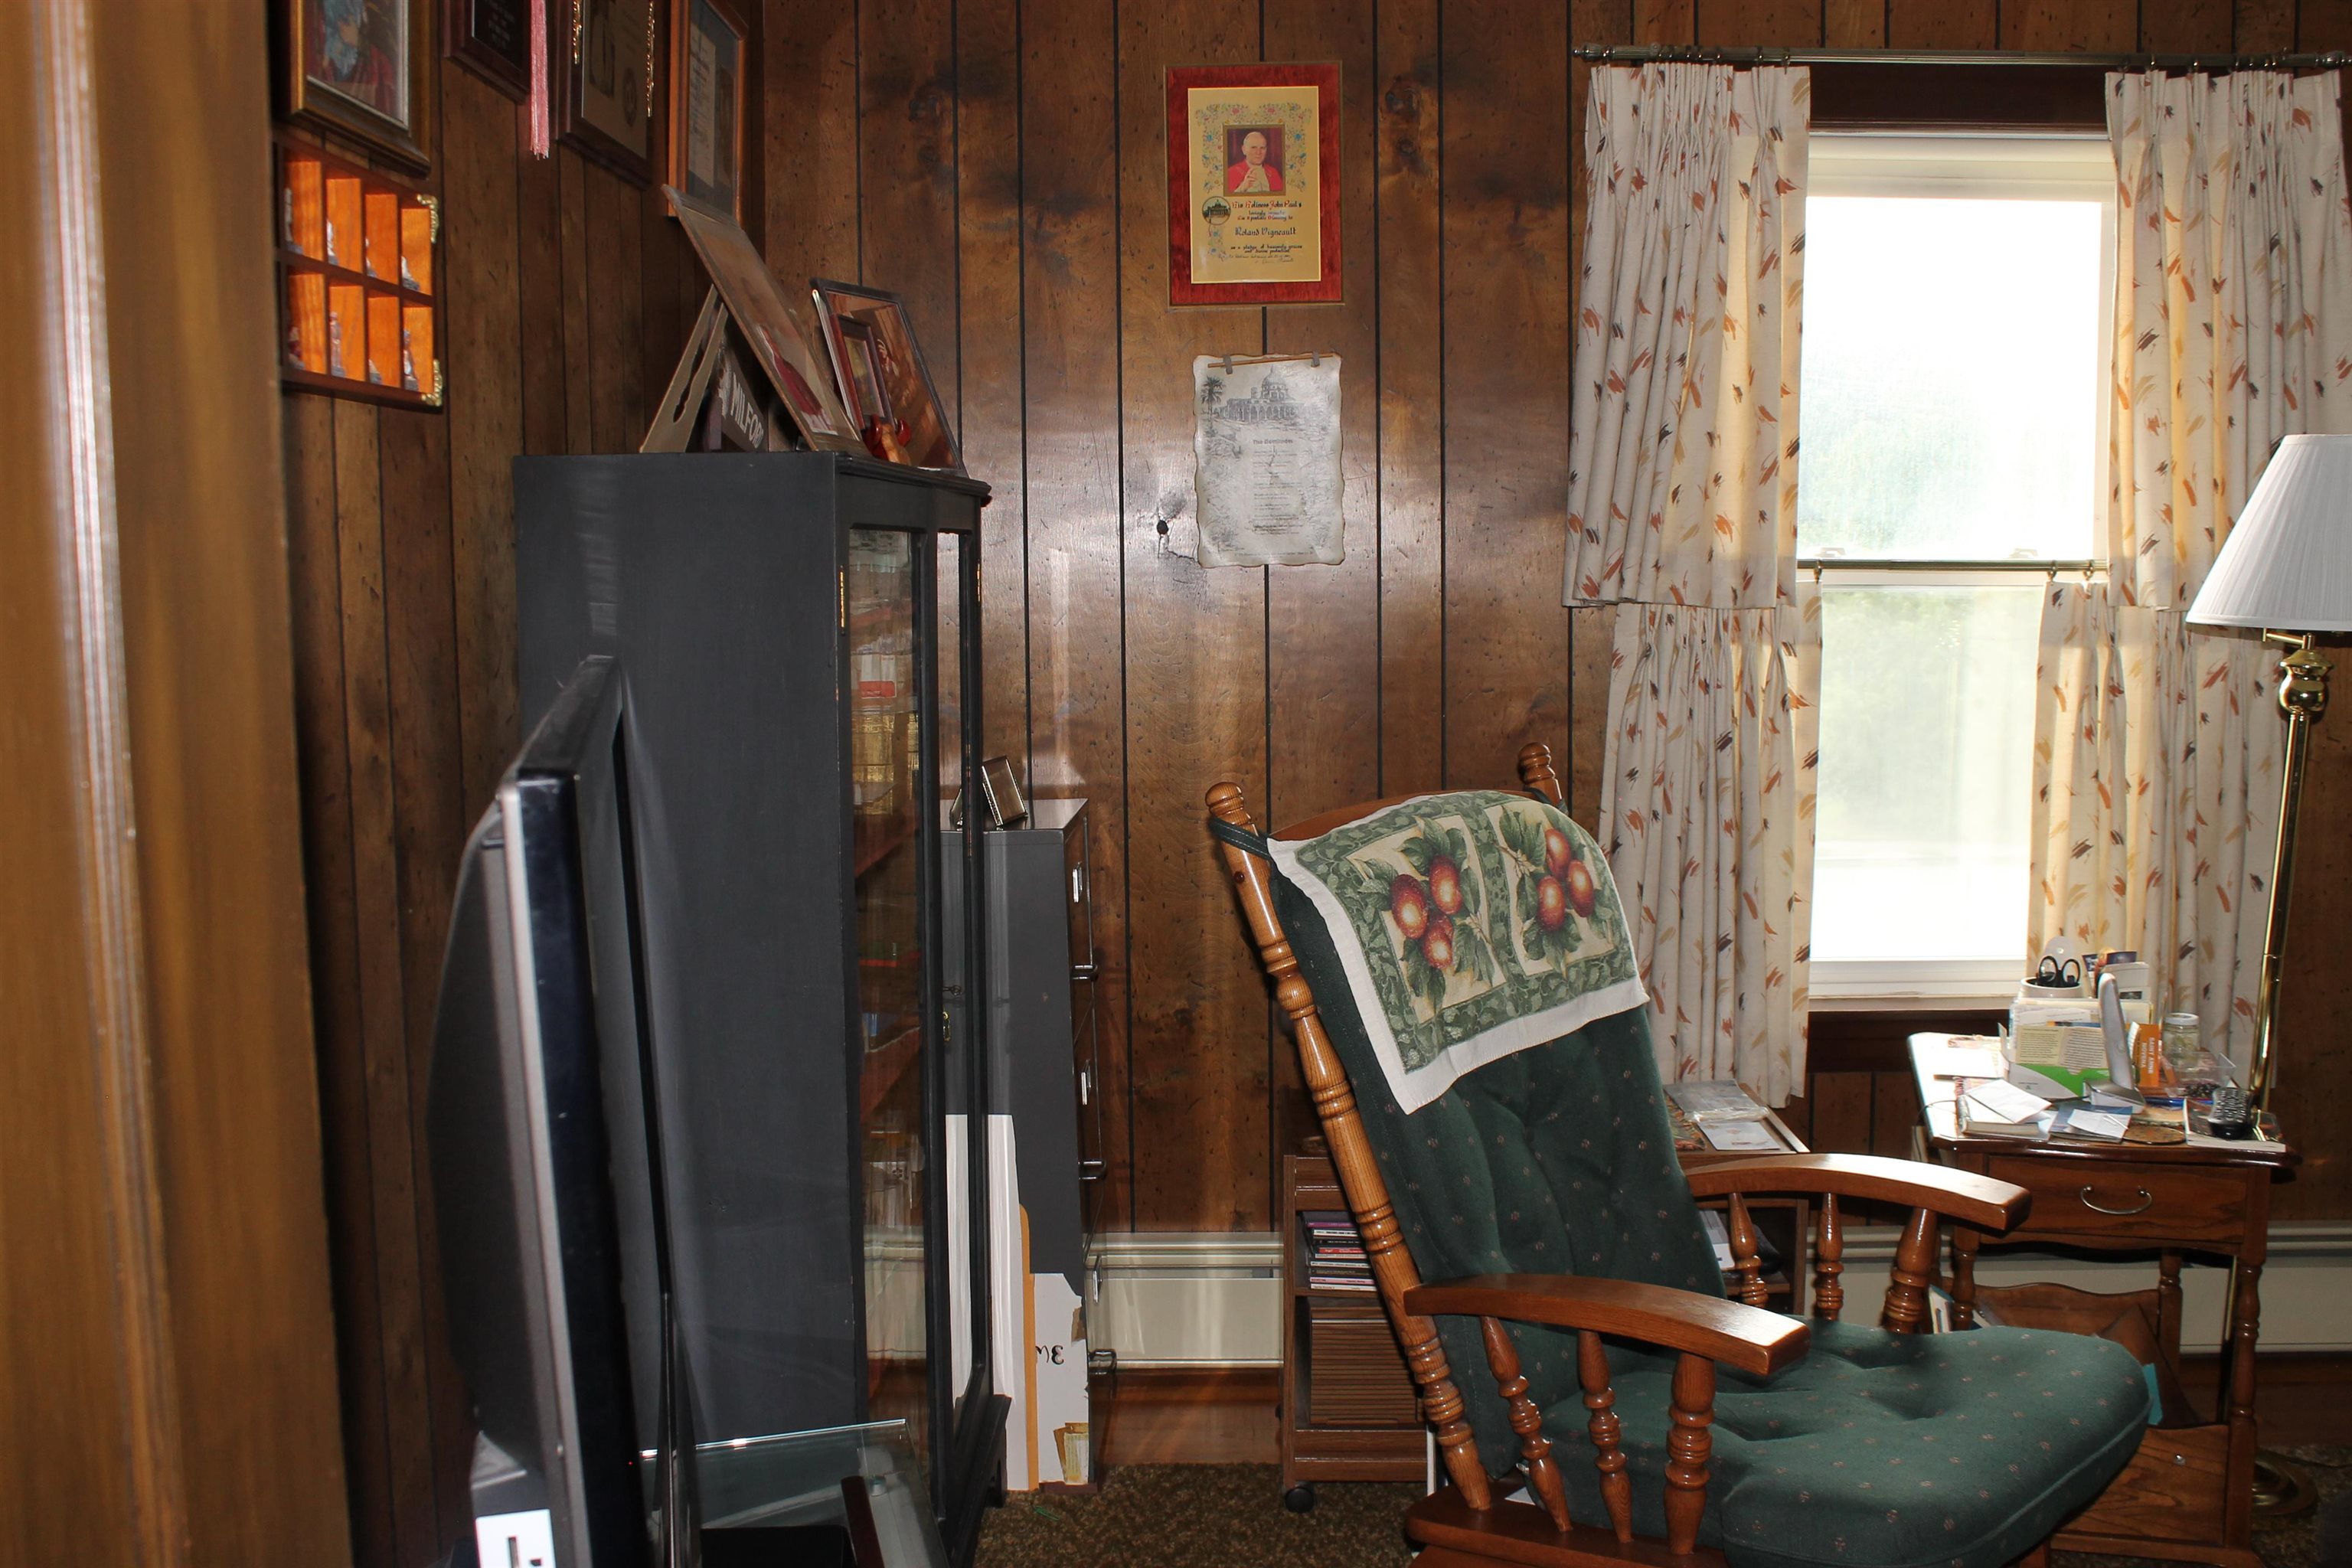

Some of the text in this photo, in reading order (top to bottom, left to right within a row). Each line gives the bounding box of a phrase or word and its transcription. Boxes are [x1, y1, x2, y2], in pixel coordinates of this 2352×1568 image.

[1284, 199, 1297, 208] Paul
[1235, 227, 1296, 238] Roland Vigneault
